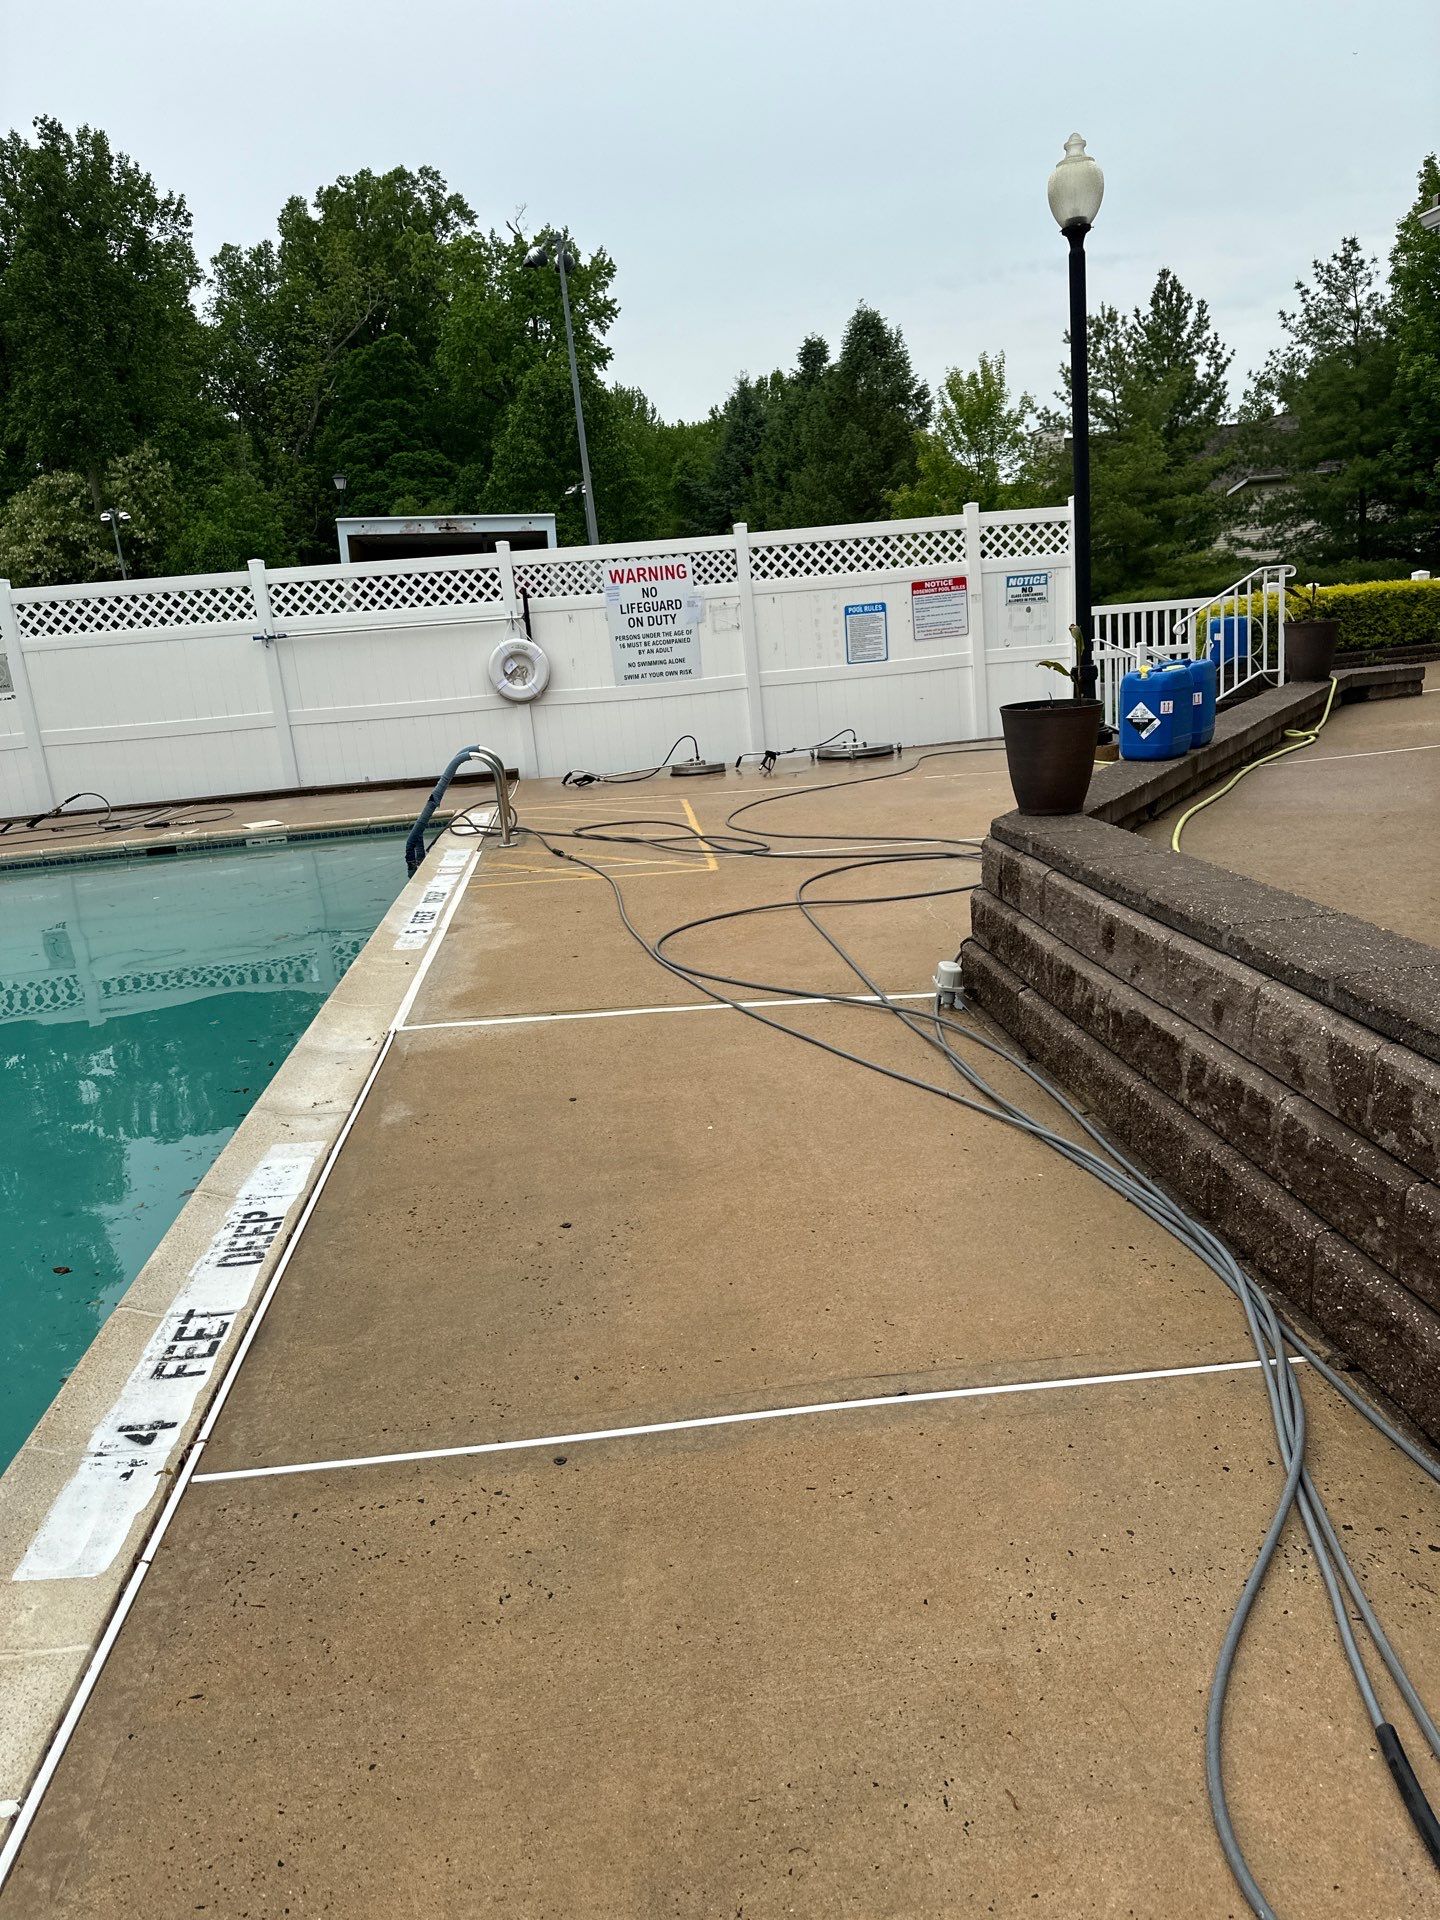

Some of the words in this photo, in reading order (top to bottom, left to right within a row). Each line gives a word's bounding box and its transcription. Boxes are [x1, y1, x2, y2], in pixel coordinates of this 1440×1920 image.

[609, 564, 687, 584] WARNING
[1008, 575, 1046, 586] NOTICE
[924, 579, 954, 588] NOTICE
[642, 587, 658, 598] NO
[620, 599, 682, 614] LIFEGUARD
[628, 617, 644, 628] ON
[648, 614, 676, 626] DUTY
[652, 638, 690, 646] ACCOMPANIED
[410, 910, 437, 924] FEET
[117, 1420, 178, 1446] 4
[151, 1308, 236, 1380] FEET
[216, 1210, 285, 1268] DEEP
